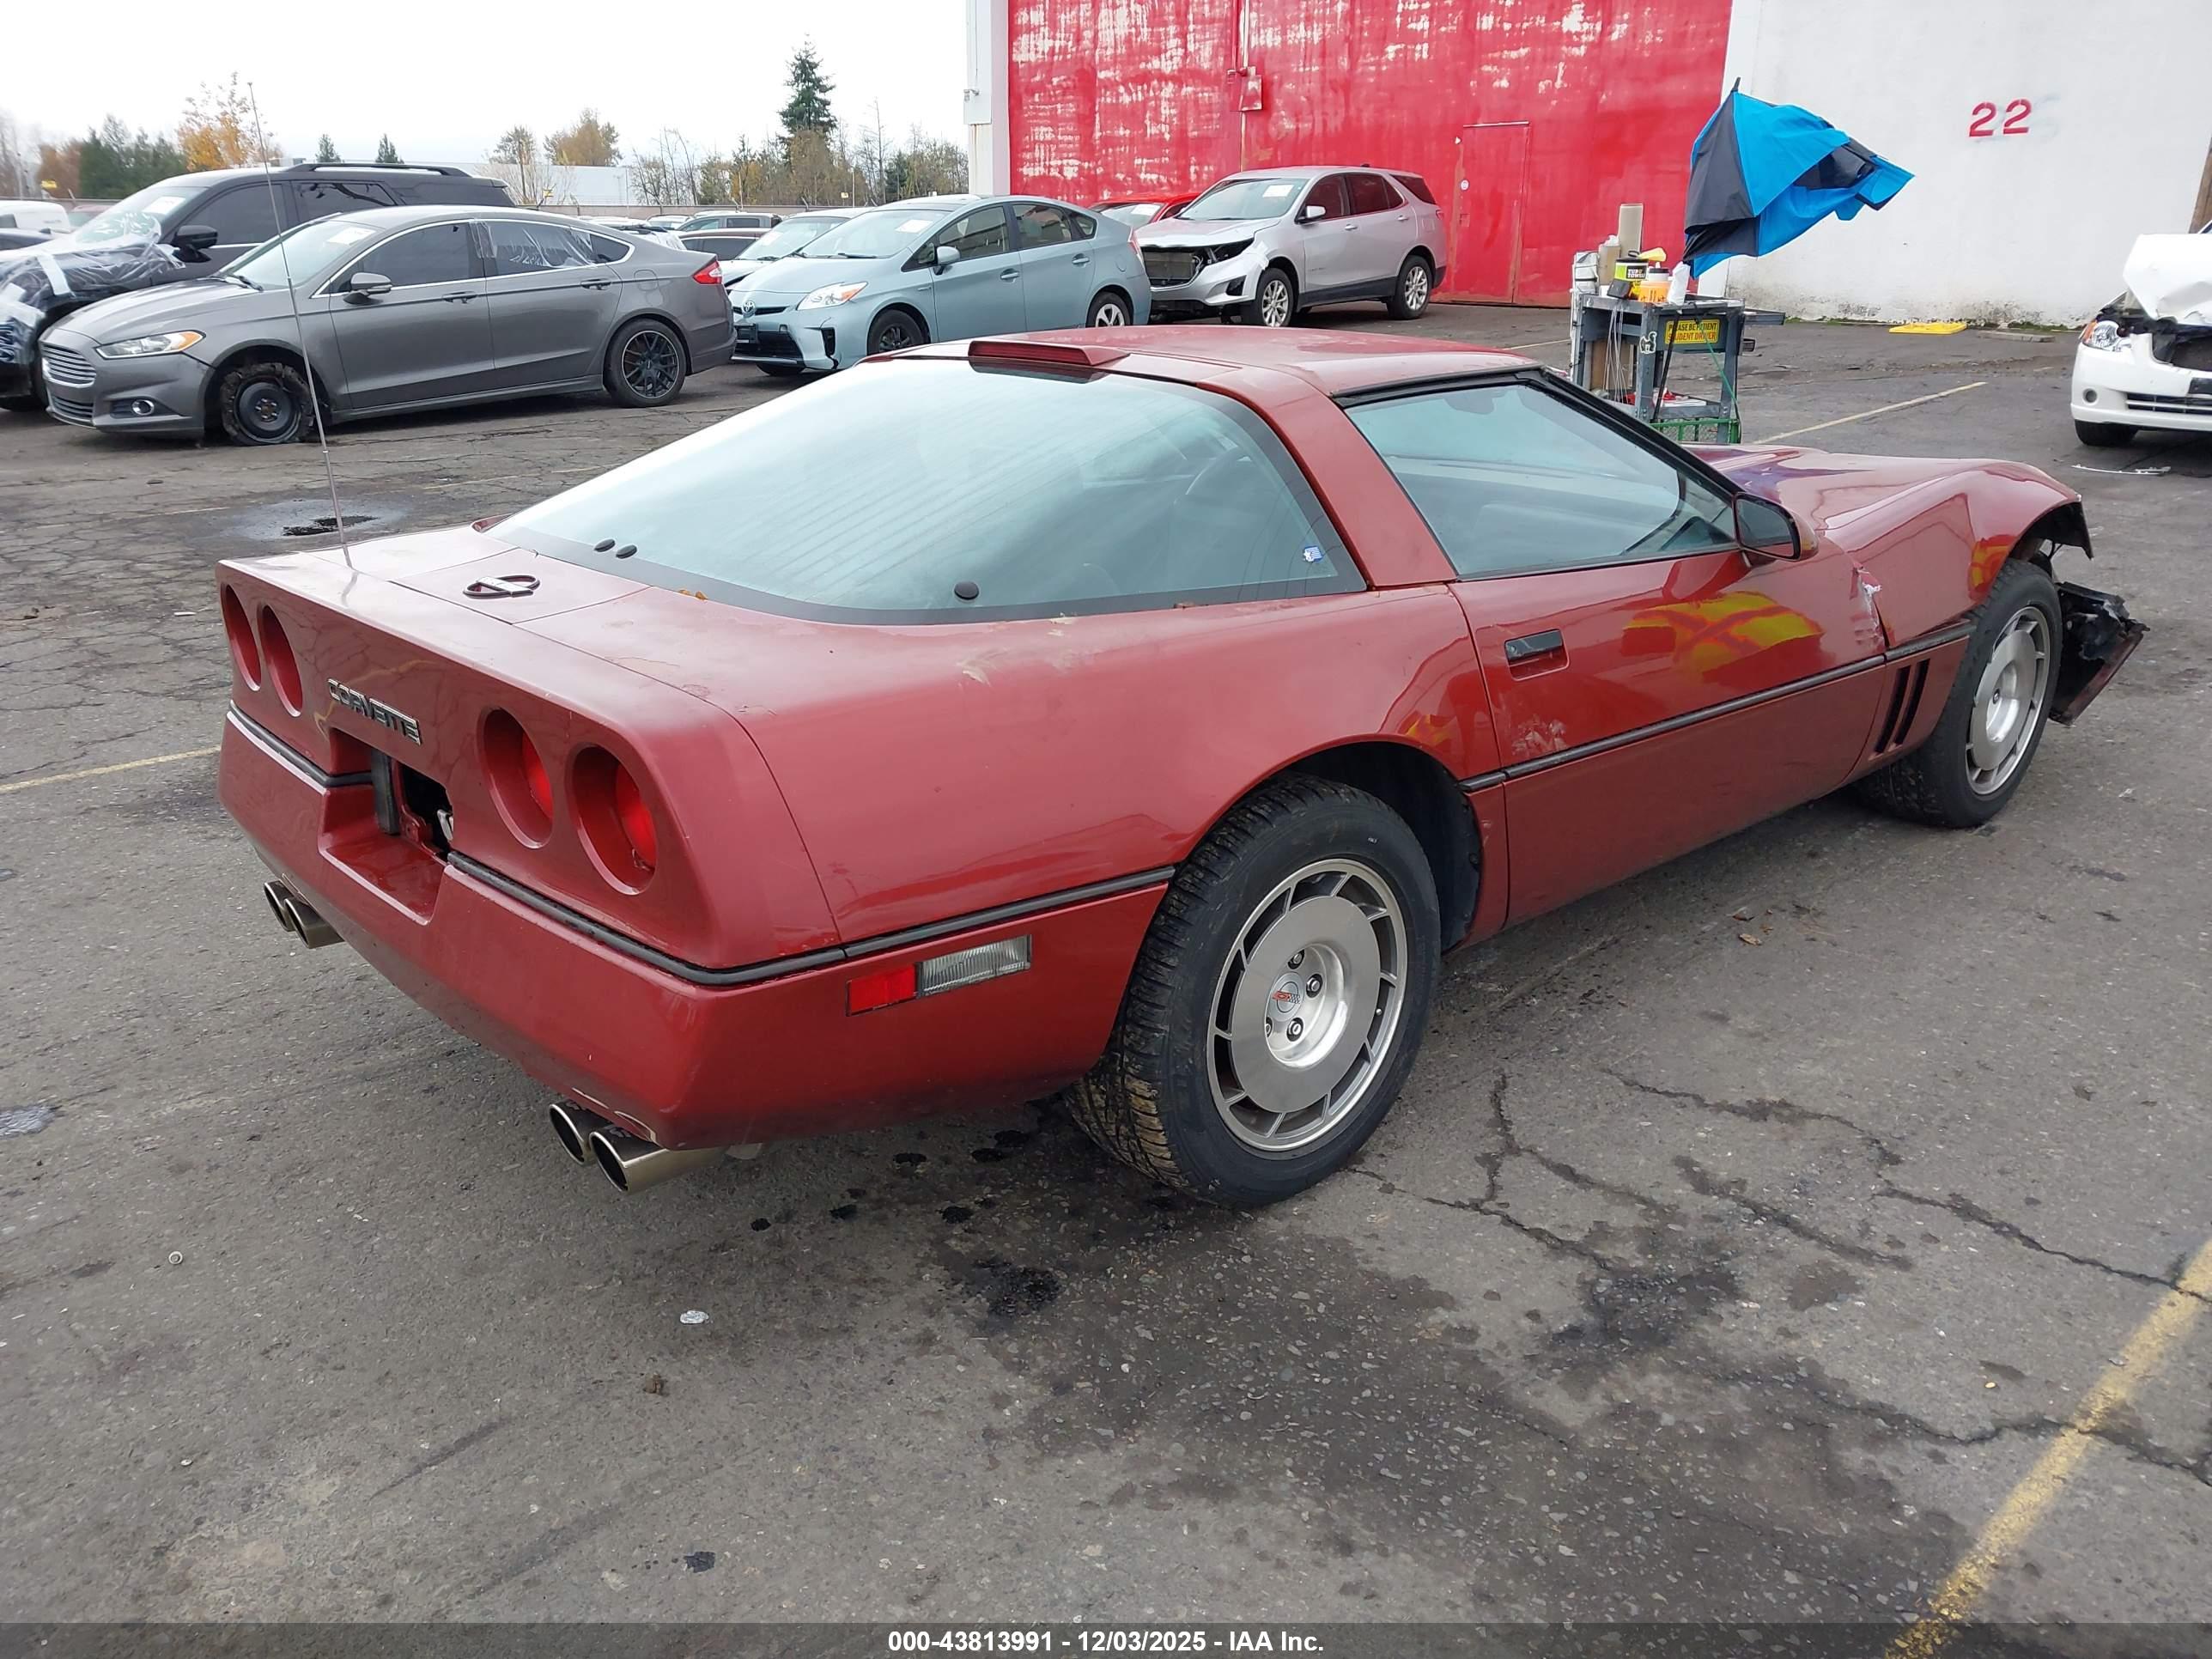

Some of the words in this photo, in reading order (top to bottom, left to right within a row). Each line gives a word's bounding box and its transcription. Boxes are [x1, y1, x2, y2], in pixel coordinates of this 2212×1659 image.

[1968, 98, 2032, 137] 22
[1668, 332, 1694, 341] SUDENT
[327, 678, 422, 745] CORVETTE
